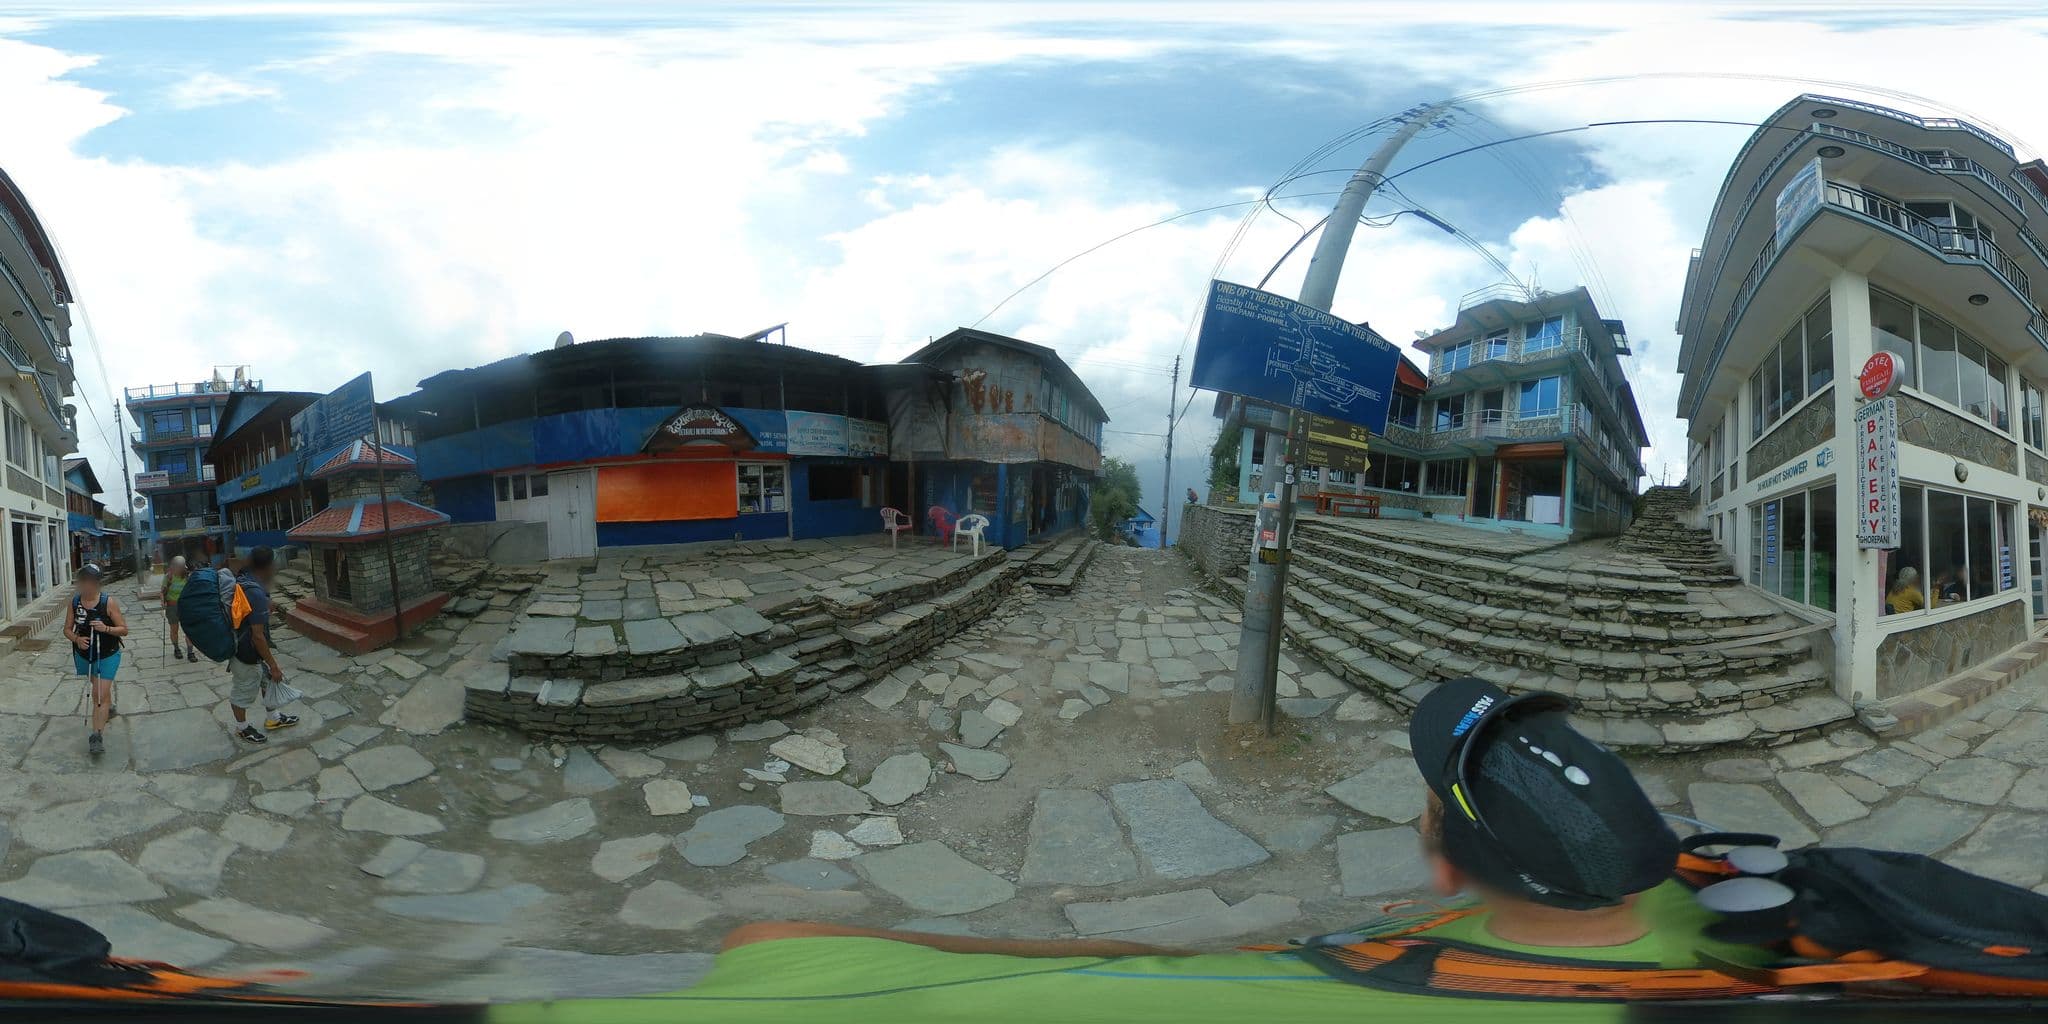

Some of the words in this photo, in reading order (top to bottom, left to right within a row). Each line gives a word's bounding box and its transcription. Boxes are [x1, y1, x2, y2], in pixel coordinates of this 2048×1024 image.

[1217, 283, 1236, 295] ONE
[1237, 287, 1249, 298] OF
[1250, 290, 1268, 303] THE
[1268, 294, 1292, 310] BEST
[1293, 303, 1316, 319] VIEW
[1316, 312, 1342, 329] POINT
[1342, 322, 1351, 334] IN
[1351, 327, 1366, 340] THE
[1366, 332, 1391, 353] WORLD
[1862, 356, 1889, 377] HOTEL
[1858, 399, 1885, 422] GERMAN
[1888, 400, 1896, 460] GERMAN
[1782, 459, 1808, 481] SHOWER
[1867, 419, 1879, 534] BAKERY
[1890, 468, 1898, 540] BAKERY
[1859, 534, 1890, 544] GHOREPANI
